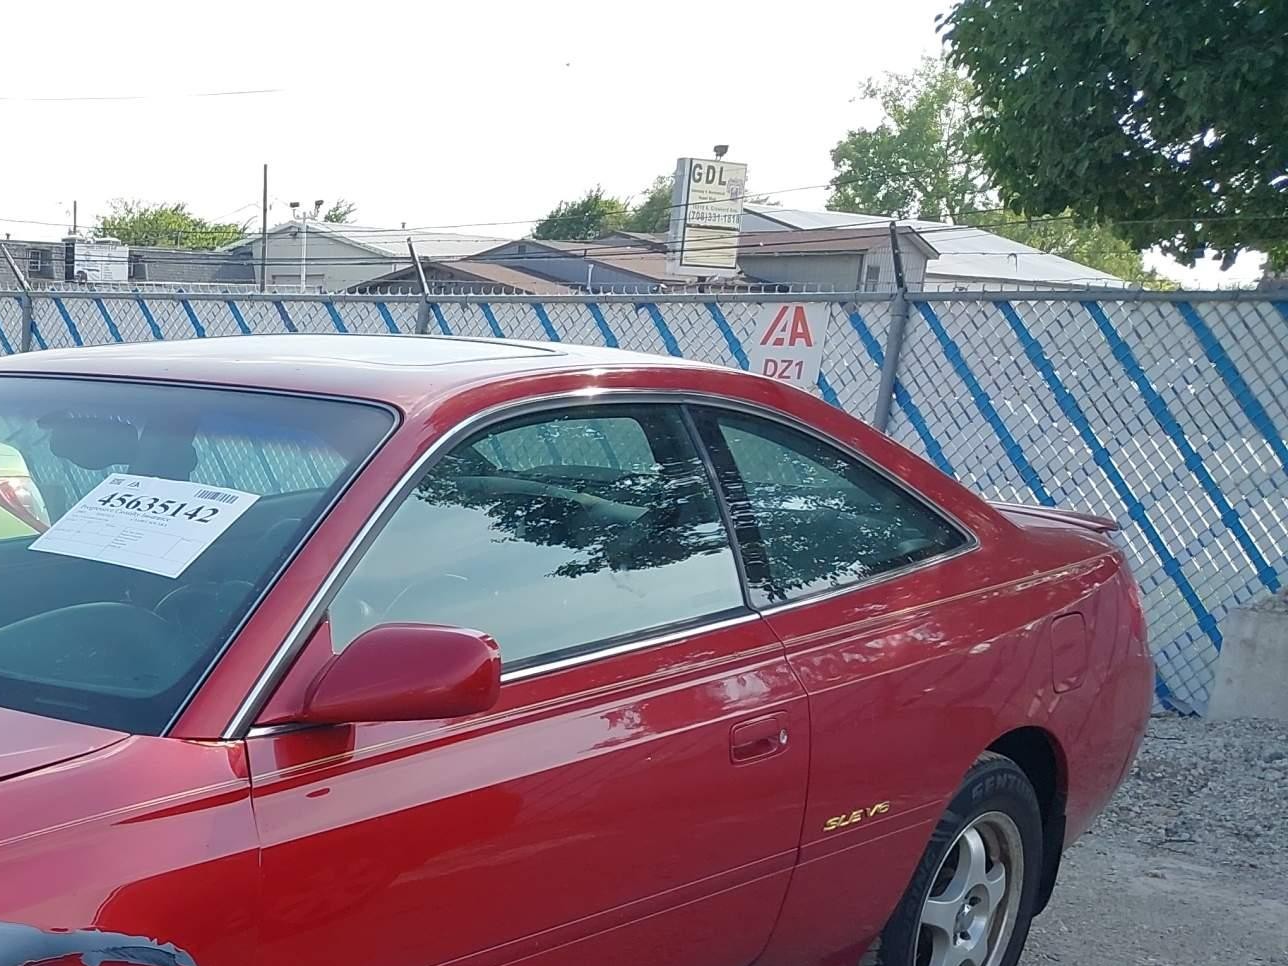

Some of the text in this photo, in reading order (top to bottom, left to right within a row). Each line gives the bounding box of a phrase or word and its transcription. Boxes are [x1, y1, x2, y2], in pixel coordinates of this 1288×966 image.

[692, 163, 727, 186] GDL
[763, 358, 804, 380] DZ1
[98, 492, 220, 524] 45635142
[823, 800, 890, 831] SLE V6
